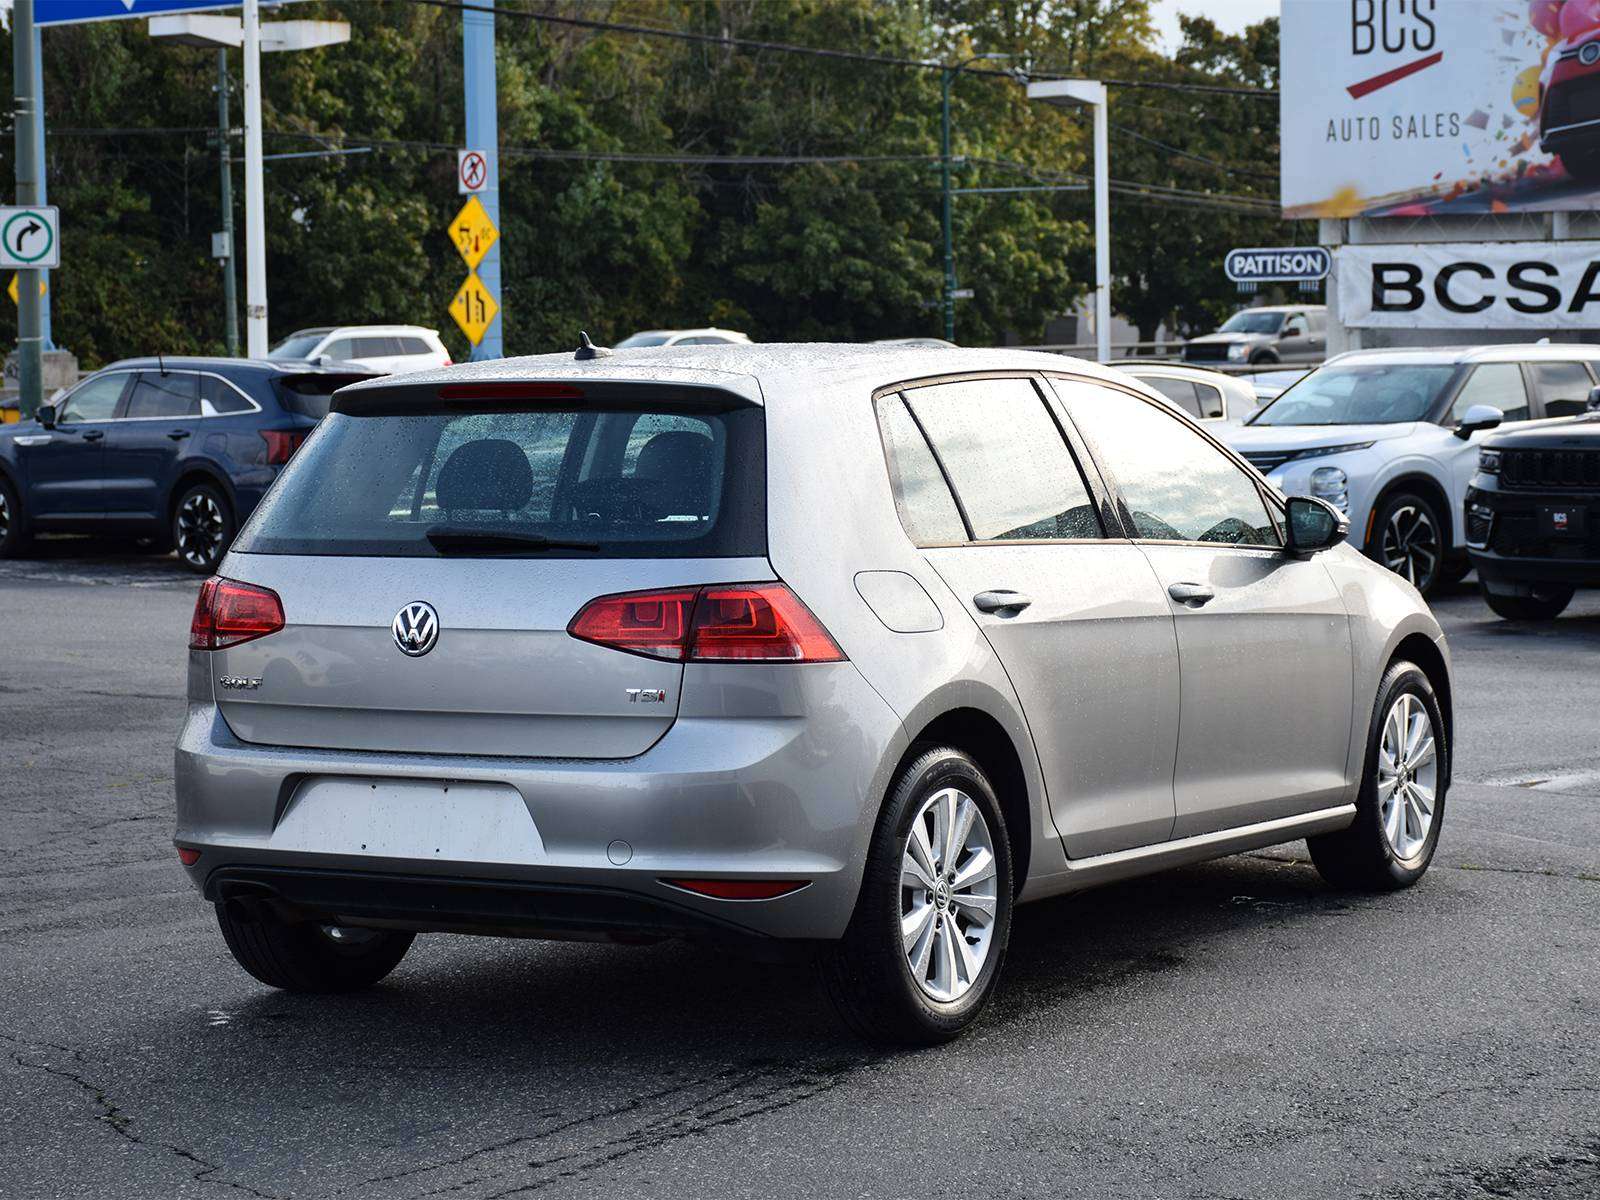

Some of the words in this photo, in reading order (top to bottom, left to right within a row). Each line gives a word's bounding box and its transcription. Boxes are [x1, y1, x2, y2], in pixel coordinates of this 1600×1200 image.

[1352, 0, 1436, 55] BCS
[1326, 117, 1380, 142] AUTO
[1392, 112, 1460, 140] SALES
[1233, 253, 1323, 275] PATTISON
[219, 675, 263, 690] GOLF
